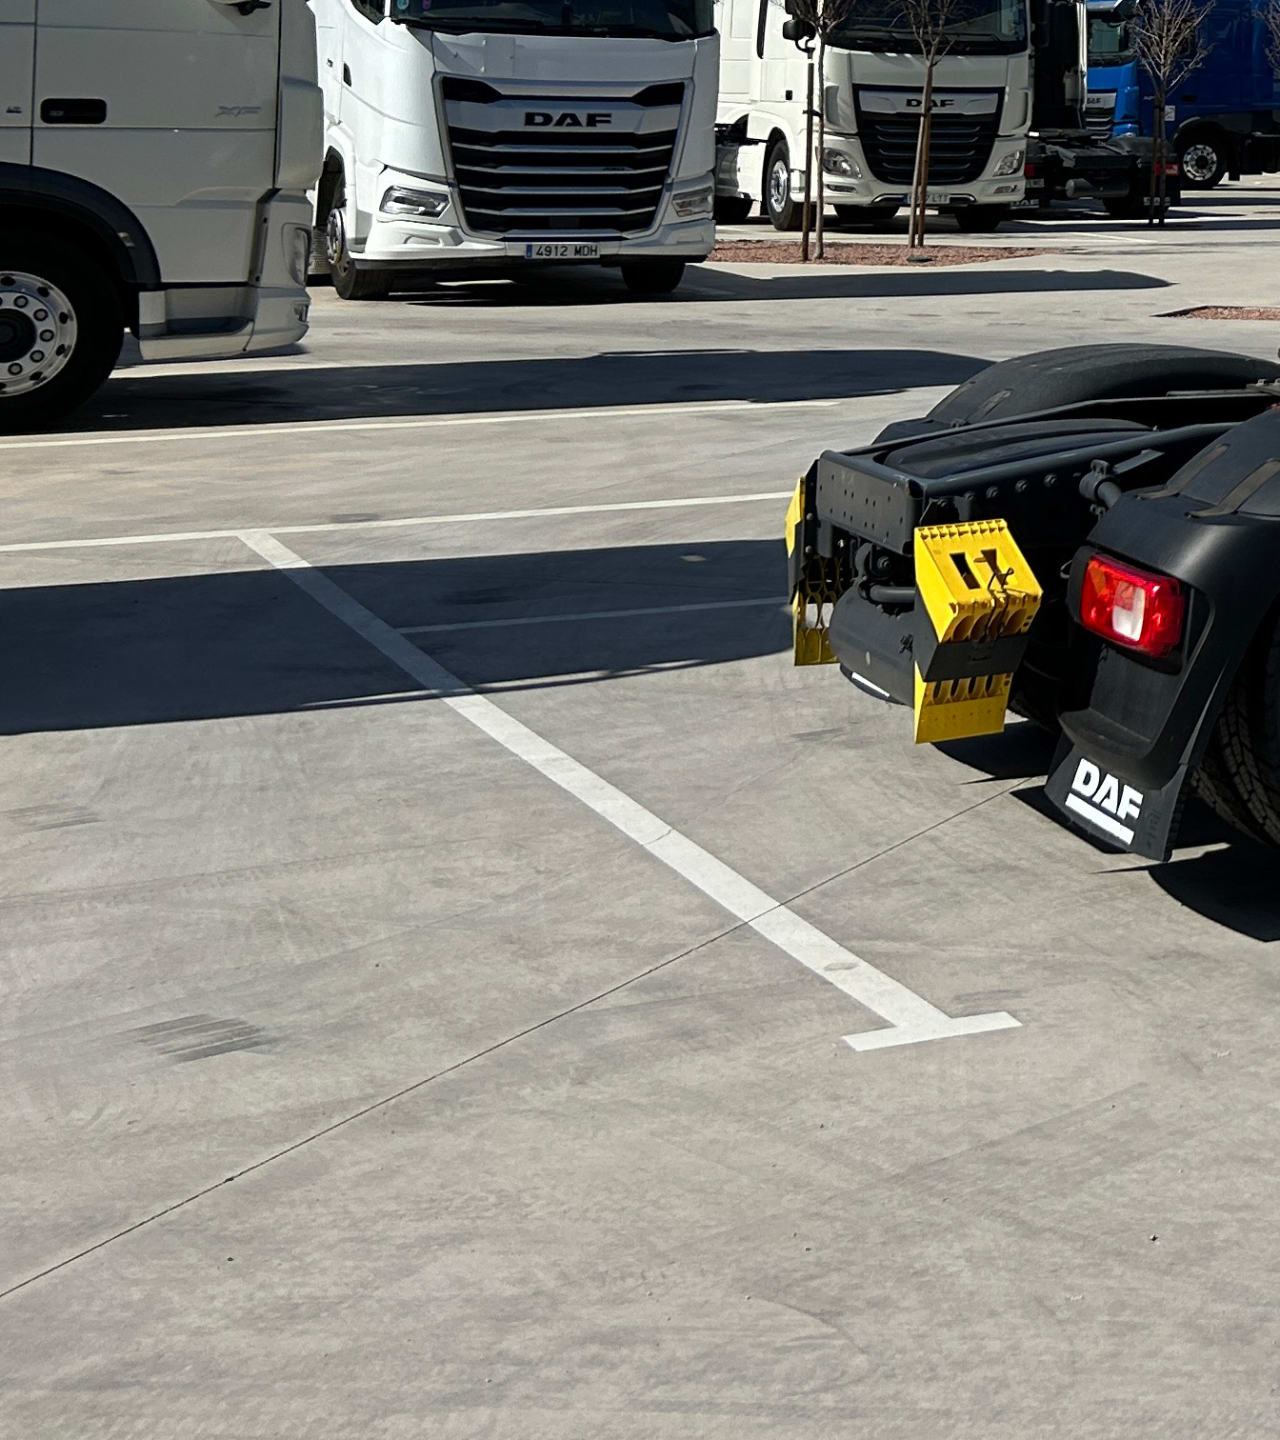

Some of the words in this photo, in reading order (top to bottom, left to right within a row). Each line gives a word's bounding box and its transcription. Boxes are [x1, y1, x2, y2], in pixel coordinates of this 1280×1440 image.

[524, 112, 612, 127] DAF
[536, 245, 568, 257] 4912
[574, 244, 598, 257] MDH
[1071, 757, 1143, 821] DAF
